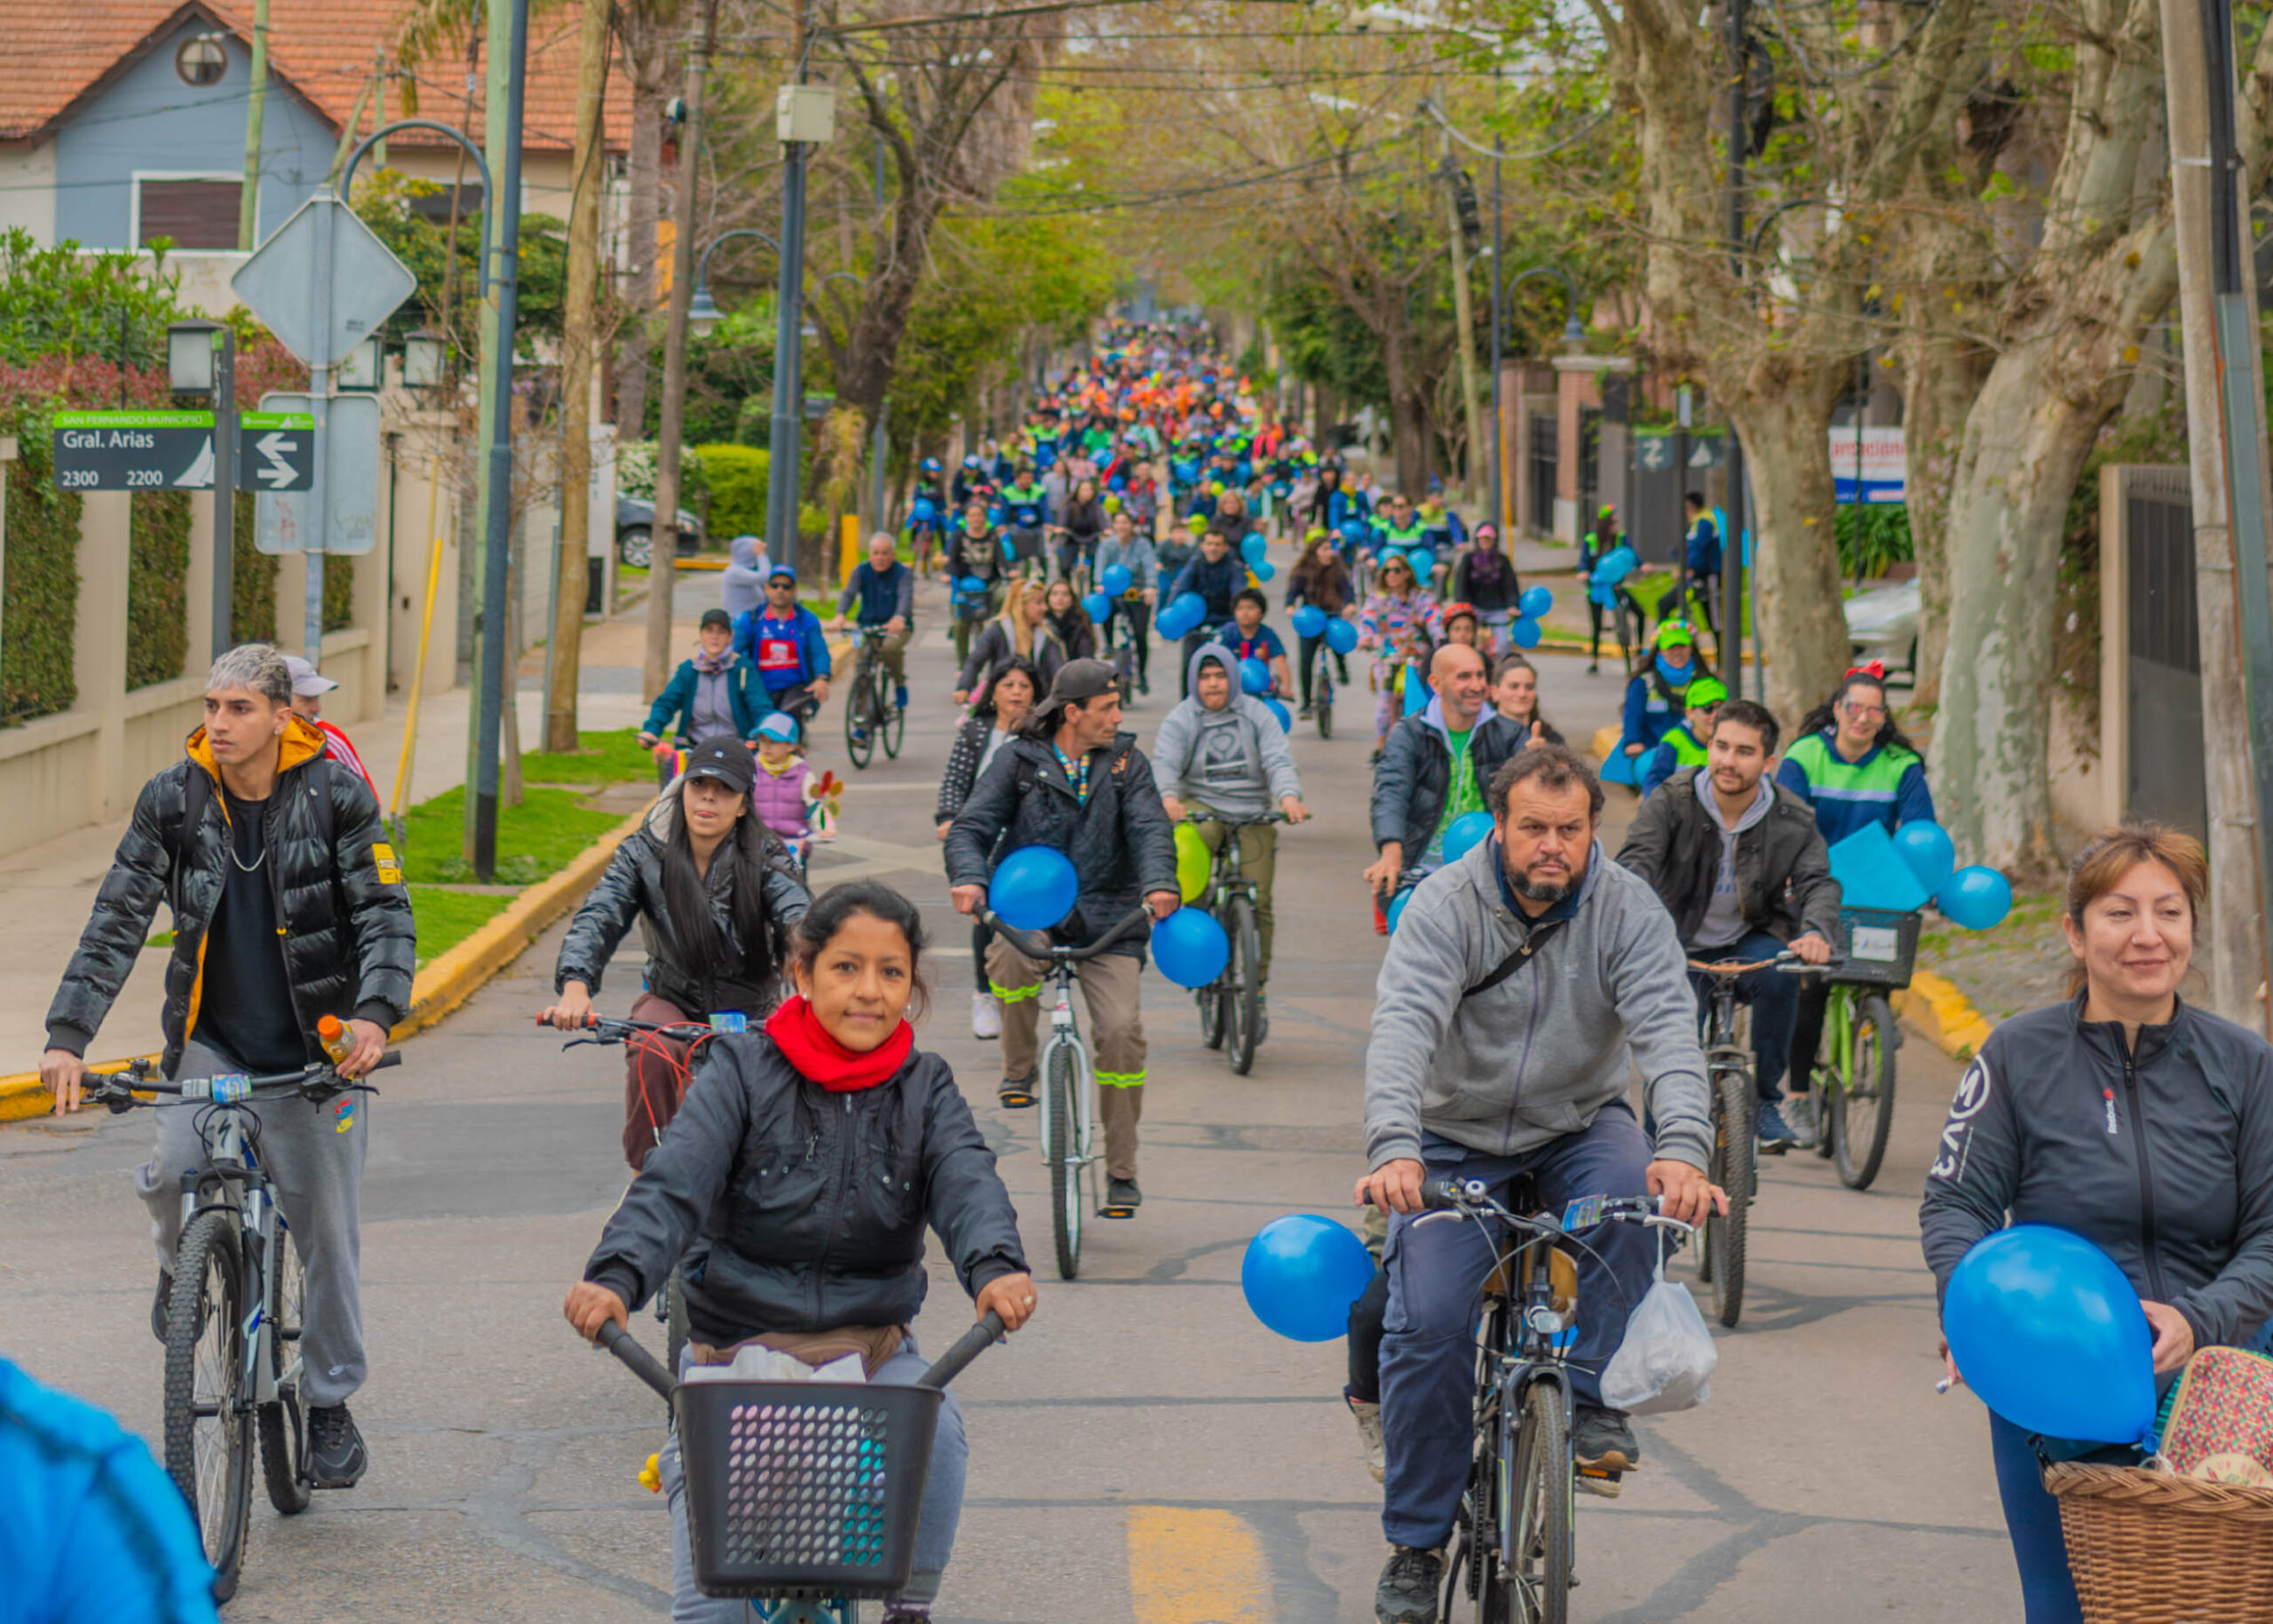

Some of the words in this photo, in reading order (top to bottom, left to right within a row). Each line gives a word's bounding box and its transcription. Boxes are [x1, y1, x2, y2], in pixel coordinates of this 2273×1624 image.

[62, 415, 84, 425] SAN
[86, 415, 145, 425] FERNANDO
[147, 415, 202, 425] MUNICIPIO
[62, 430, 105, 448] Gral.
[108, 430, 155, 448] Arias
[62, 470, 99, 487] 2300
[126, 470, 163, 487] 2200
